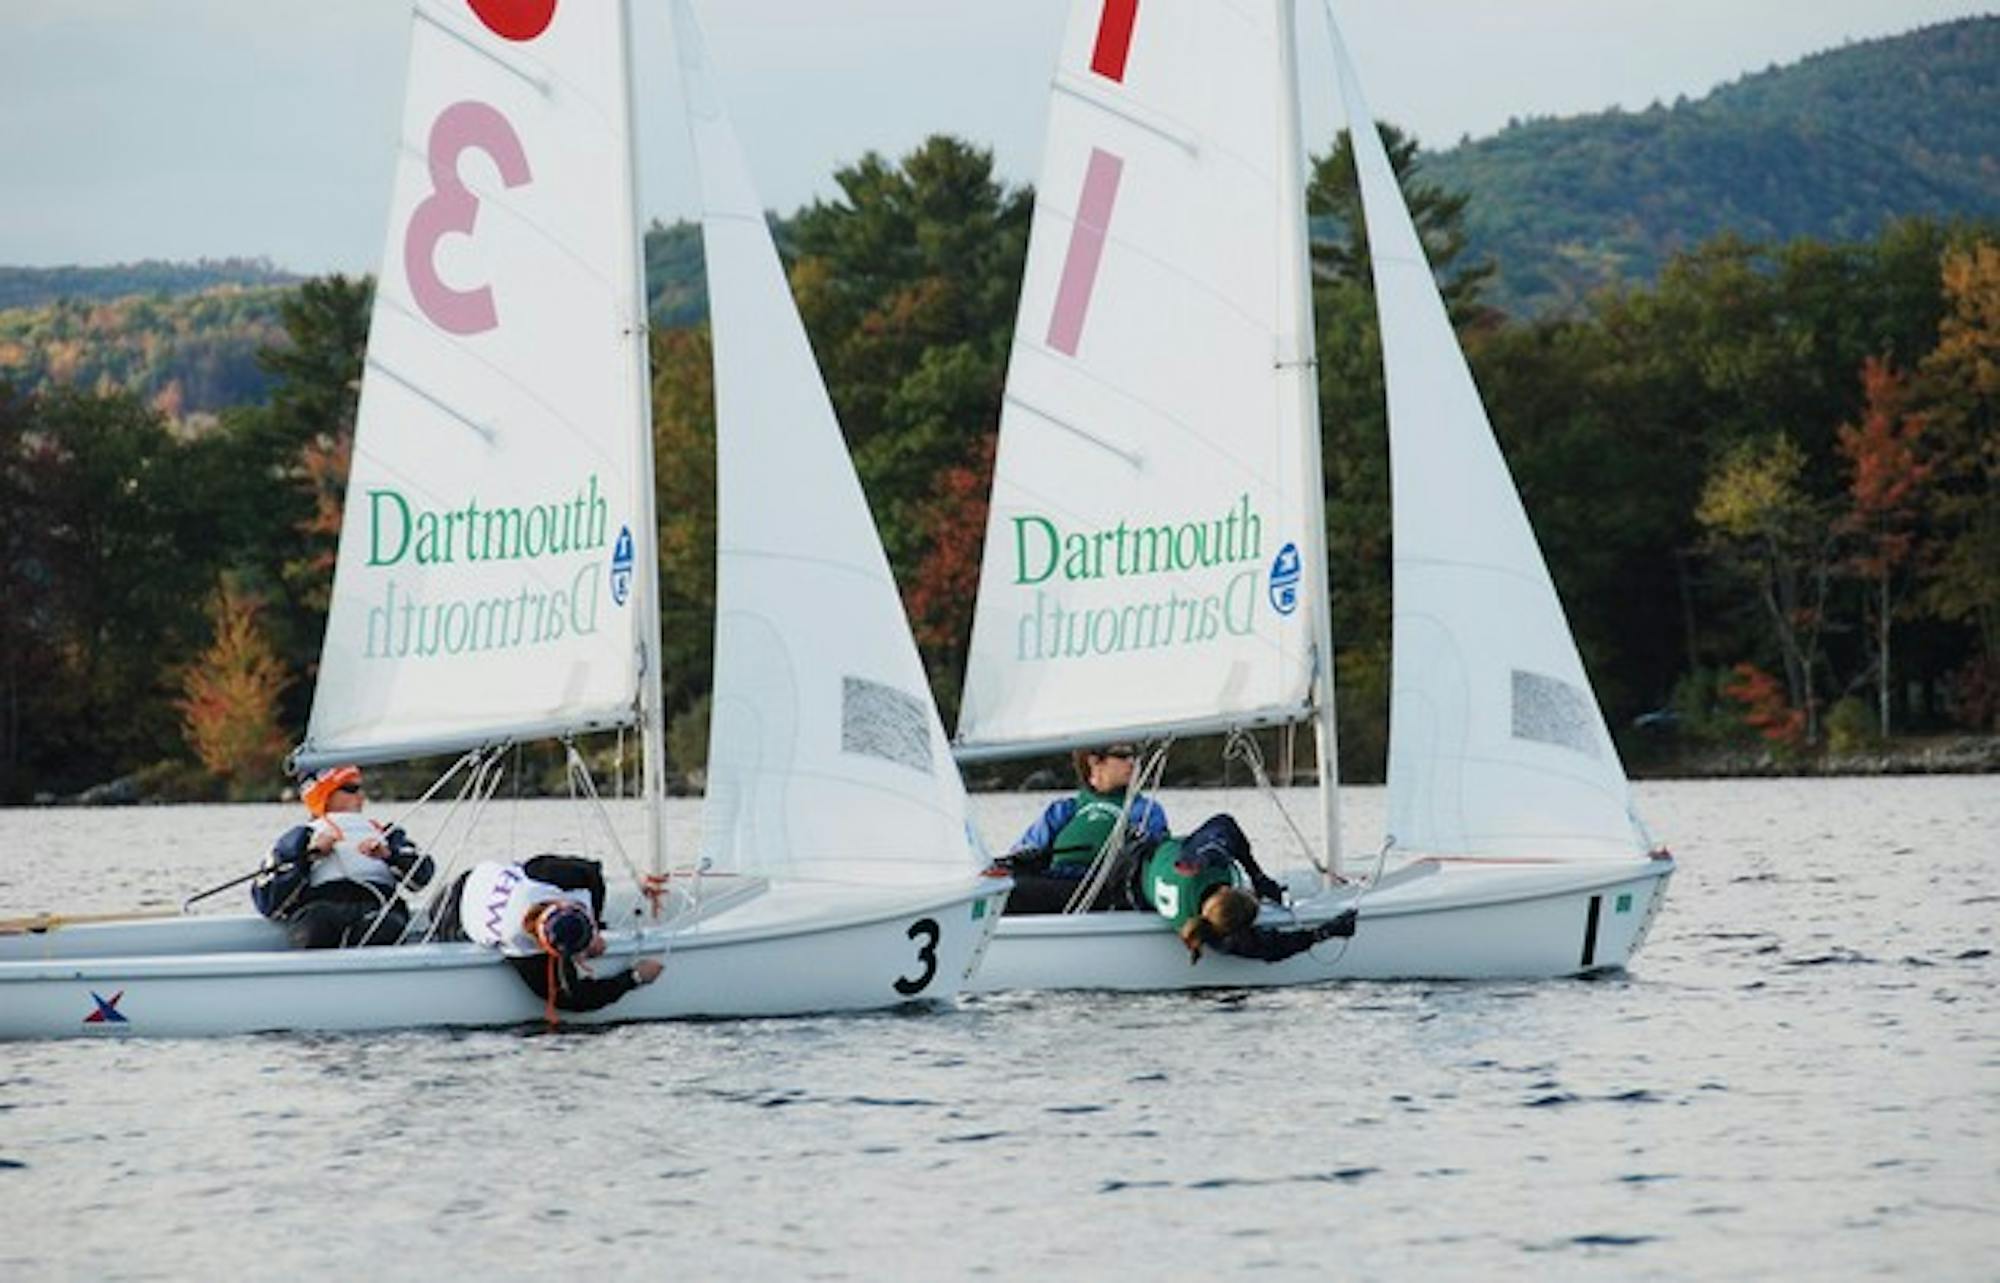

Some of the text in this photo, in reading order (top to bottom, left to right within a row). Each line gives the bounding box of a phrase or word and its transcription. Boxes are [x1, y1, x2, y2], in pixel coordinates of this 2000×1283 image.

[364, 473, 608, 567] Dartmouth
[1011, 491, 1262, 585] Dartmouth
[893, 918, 940, 995] 3
